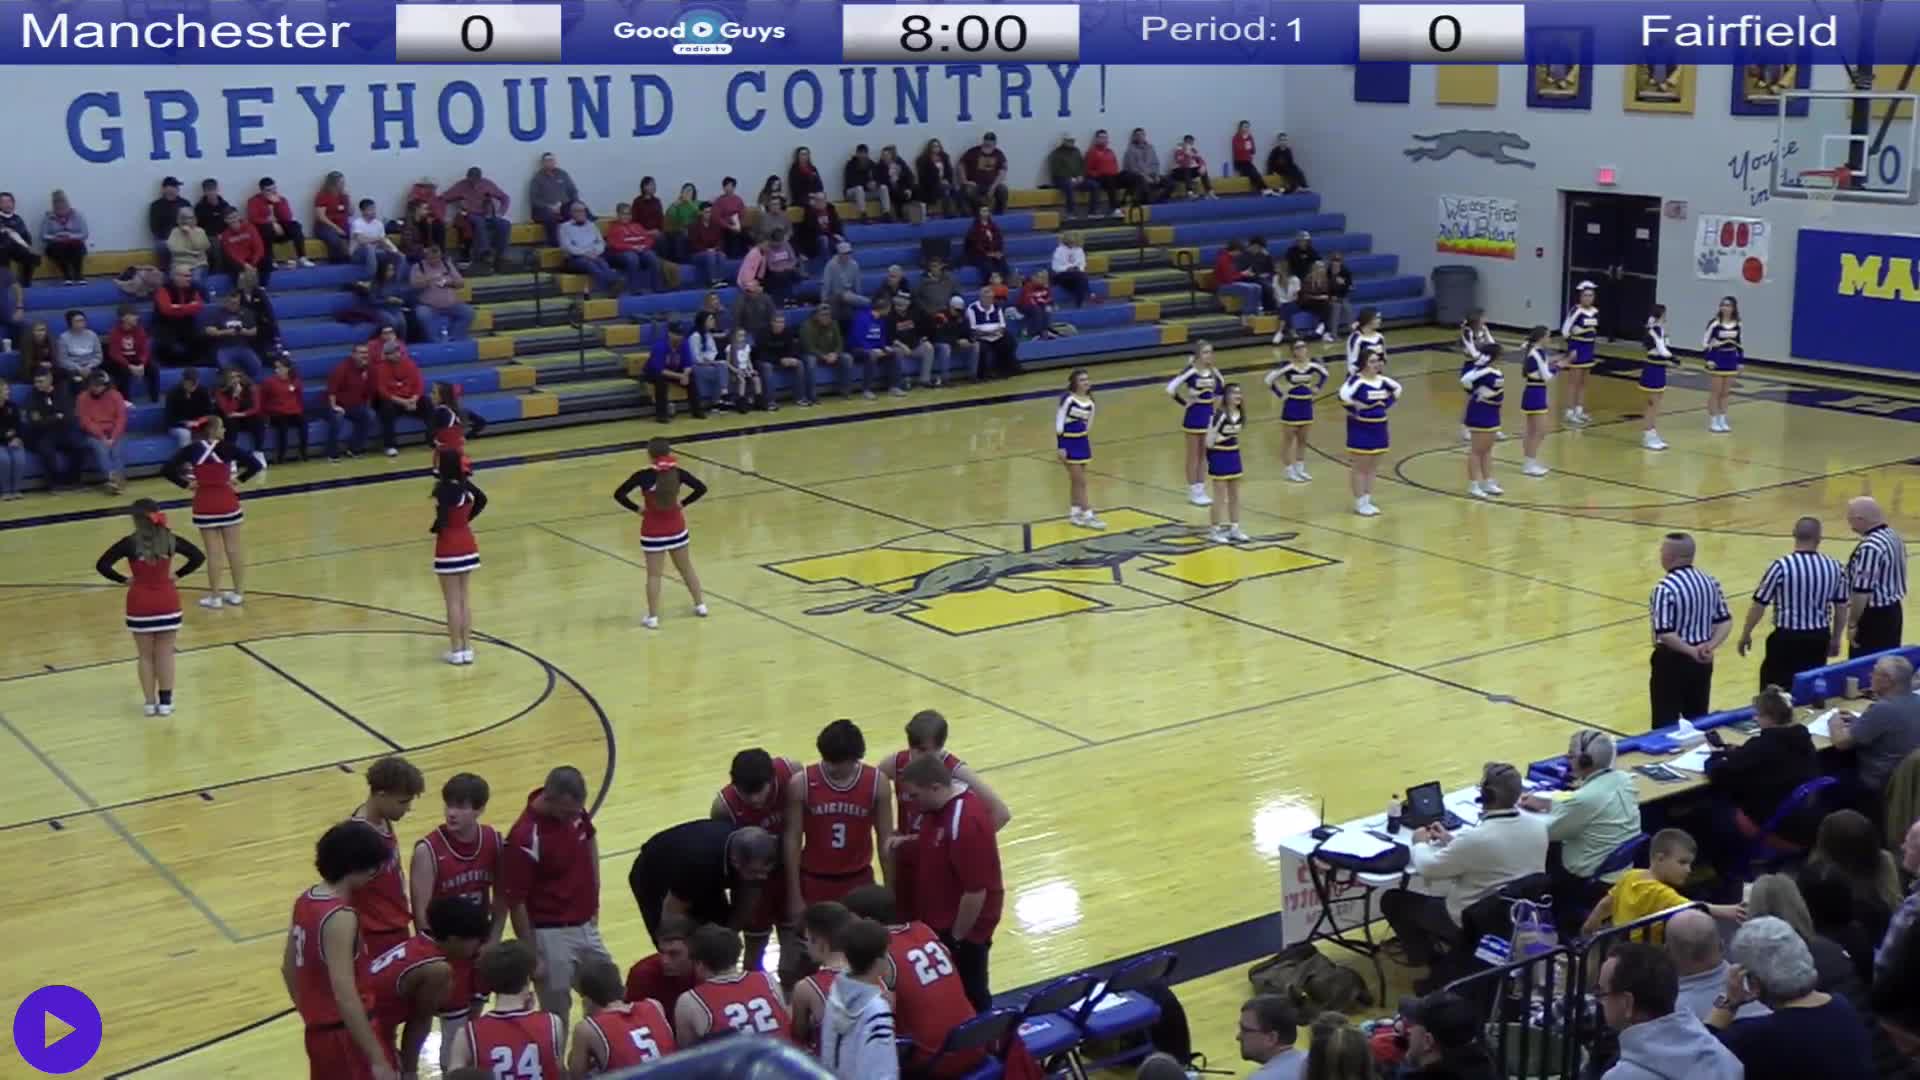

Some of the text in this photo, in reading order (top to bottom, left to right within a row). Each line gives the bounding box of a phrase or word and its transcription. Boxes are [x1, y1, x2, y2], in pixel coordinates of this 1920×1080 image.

[66, 64, 1107, 163] GREYHOUND COUNTRY!
[1704, 218, 1765, 248] HOOP
[1838, 253, 1920, 302] MA
[831, 823, 846, 848] 3
[907, 941, 953, 985] 23
[724, 997, 779, 1033] 22
[490, 1043, 543, 1080] 24
[629, 1026, 660, 1063] 5
